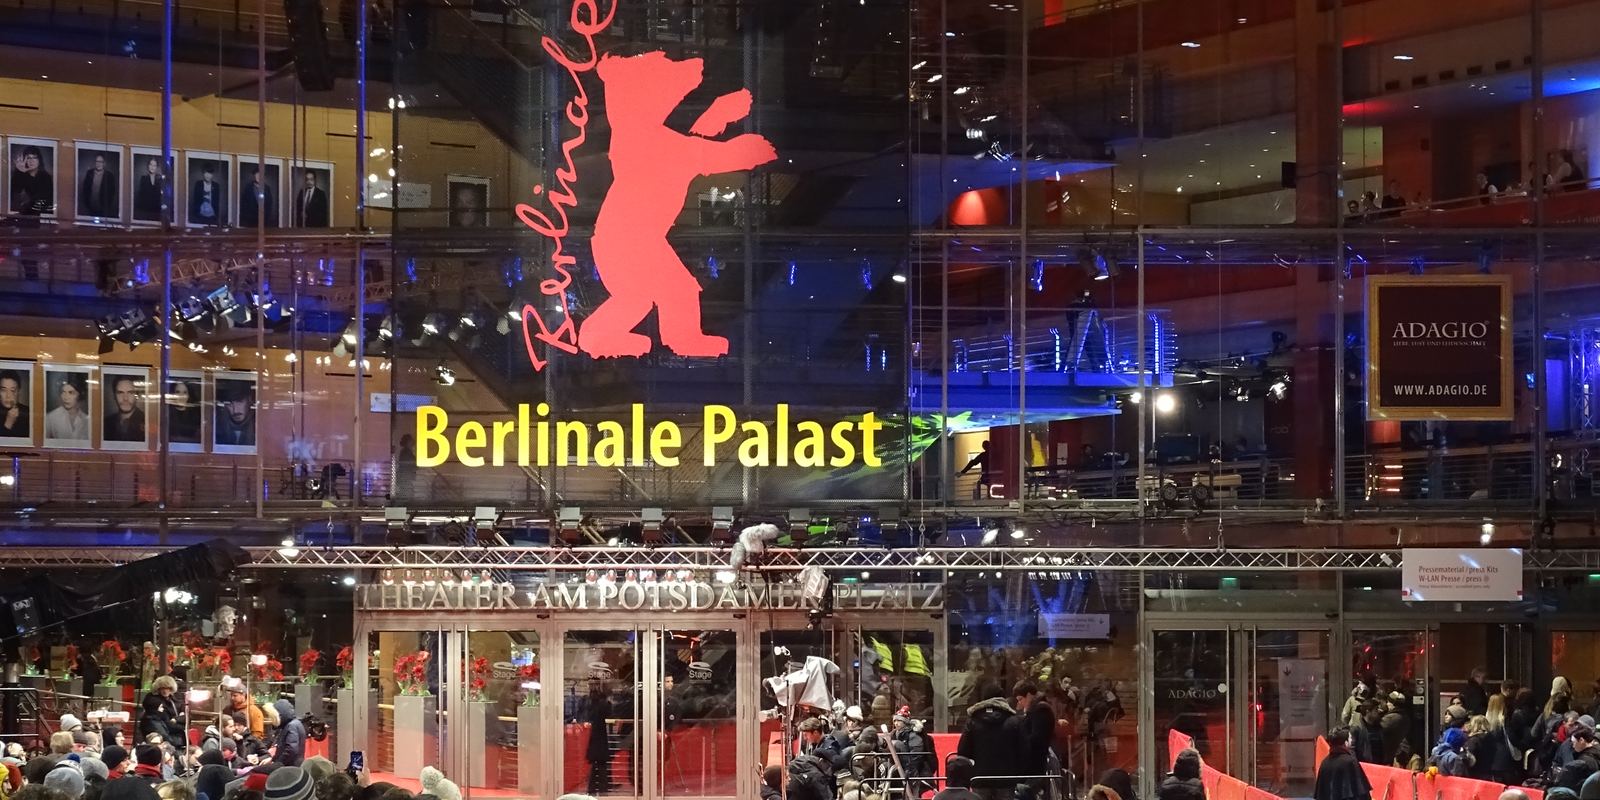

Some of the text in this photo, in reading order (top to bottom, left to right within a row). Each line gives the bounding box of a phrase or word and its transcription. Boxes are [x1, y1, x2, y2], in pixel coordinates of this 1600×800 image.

[515, 0, 617, 372] Berlinale
[1392, 322, 1487, 338] ADAGIO
[1393, 384, 1487, 395] WWW.ADAGIO.DE
[415, 403, 882, 467] Berlinale Palast
[1465, 576, 1482, 584] press
[356, 583, 519, 609] THEATER
[530, 583, 587, 609] AM
[833, 583, 945, 609] PLATZ
[492, 670, 516, 680] Stage
[588, 670, 611, 680] Stage
[688, 670, 712, 680] Stage
[1168, 689, 1216, 699] ADAGIO
